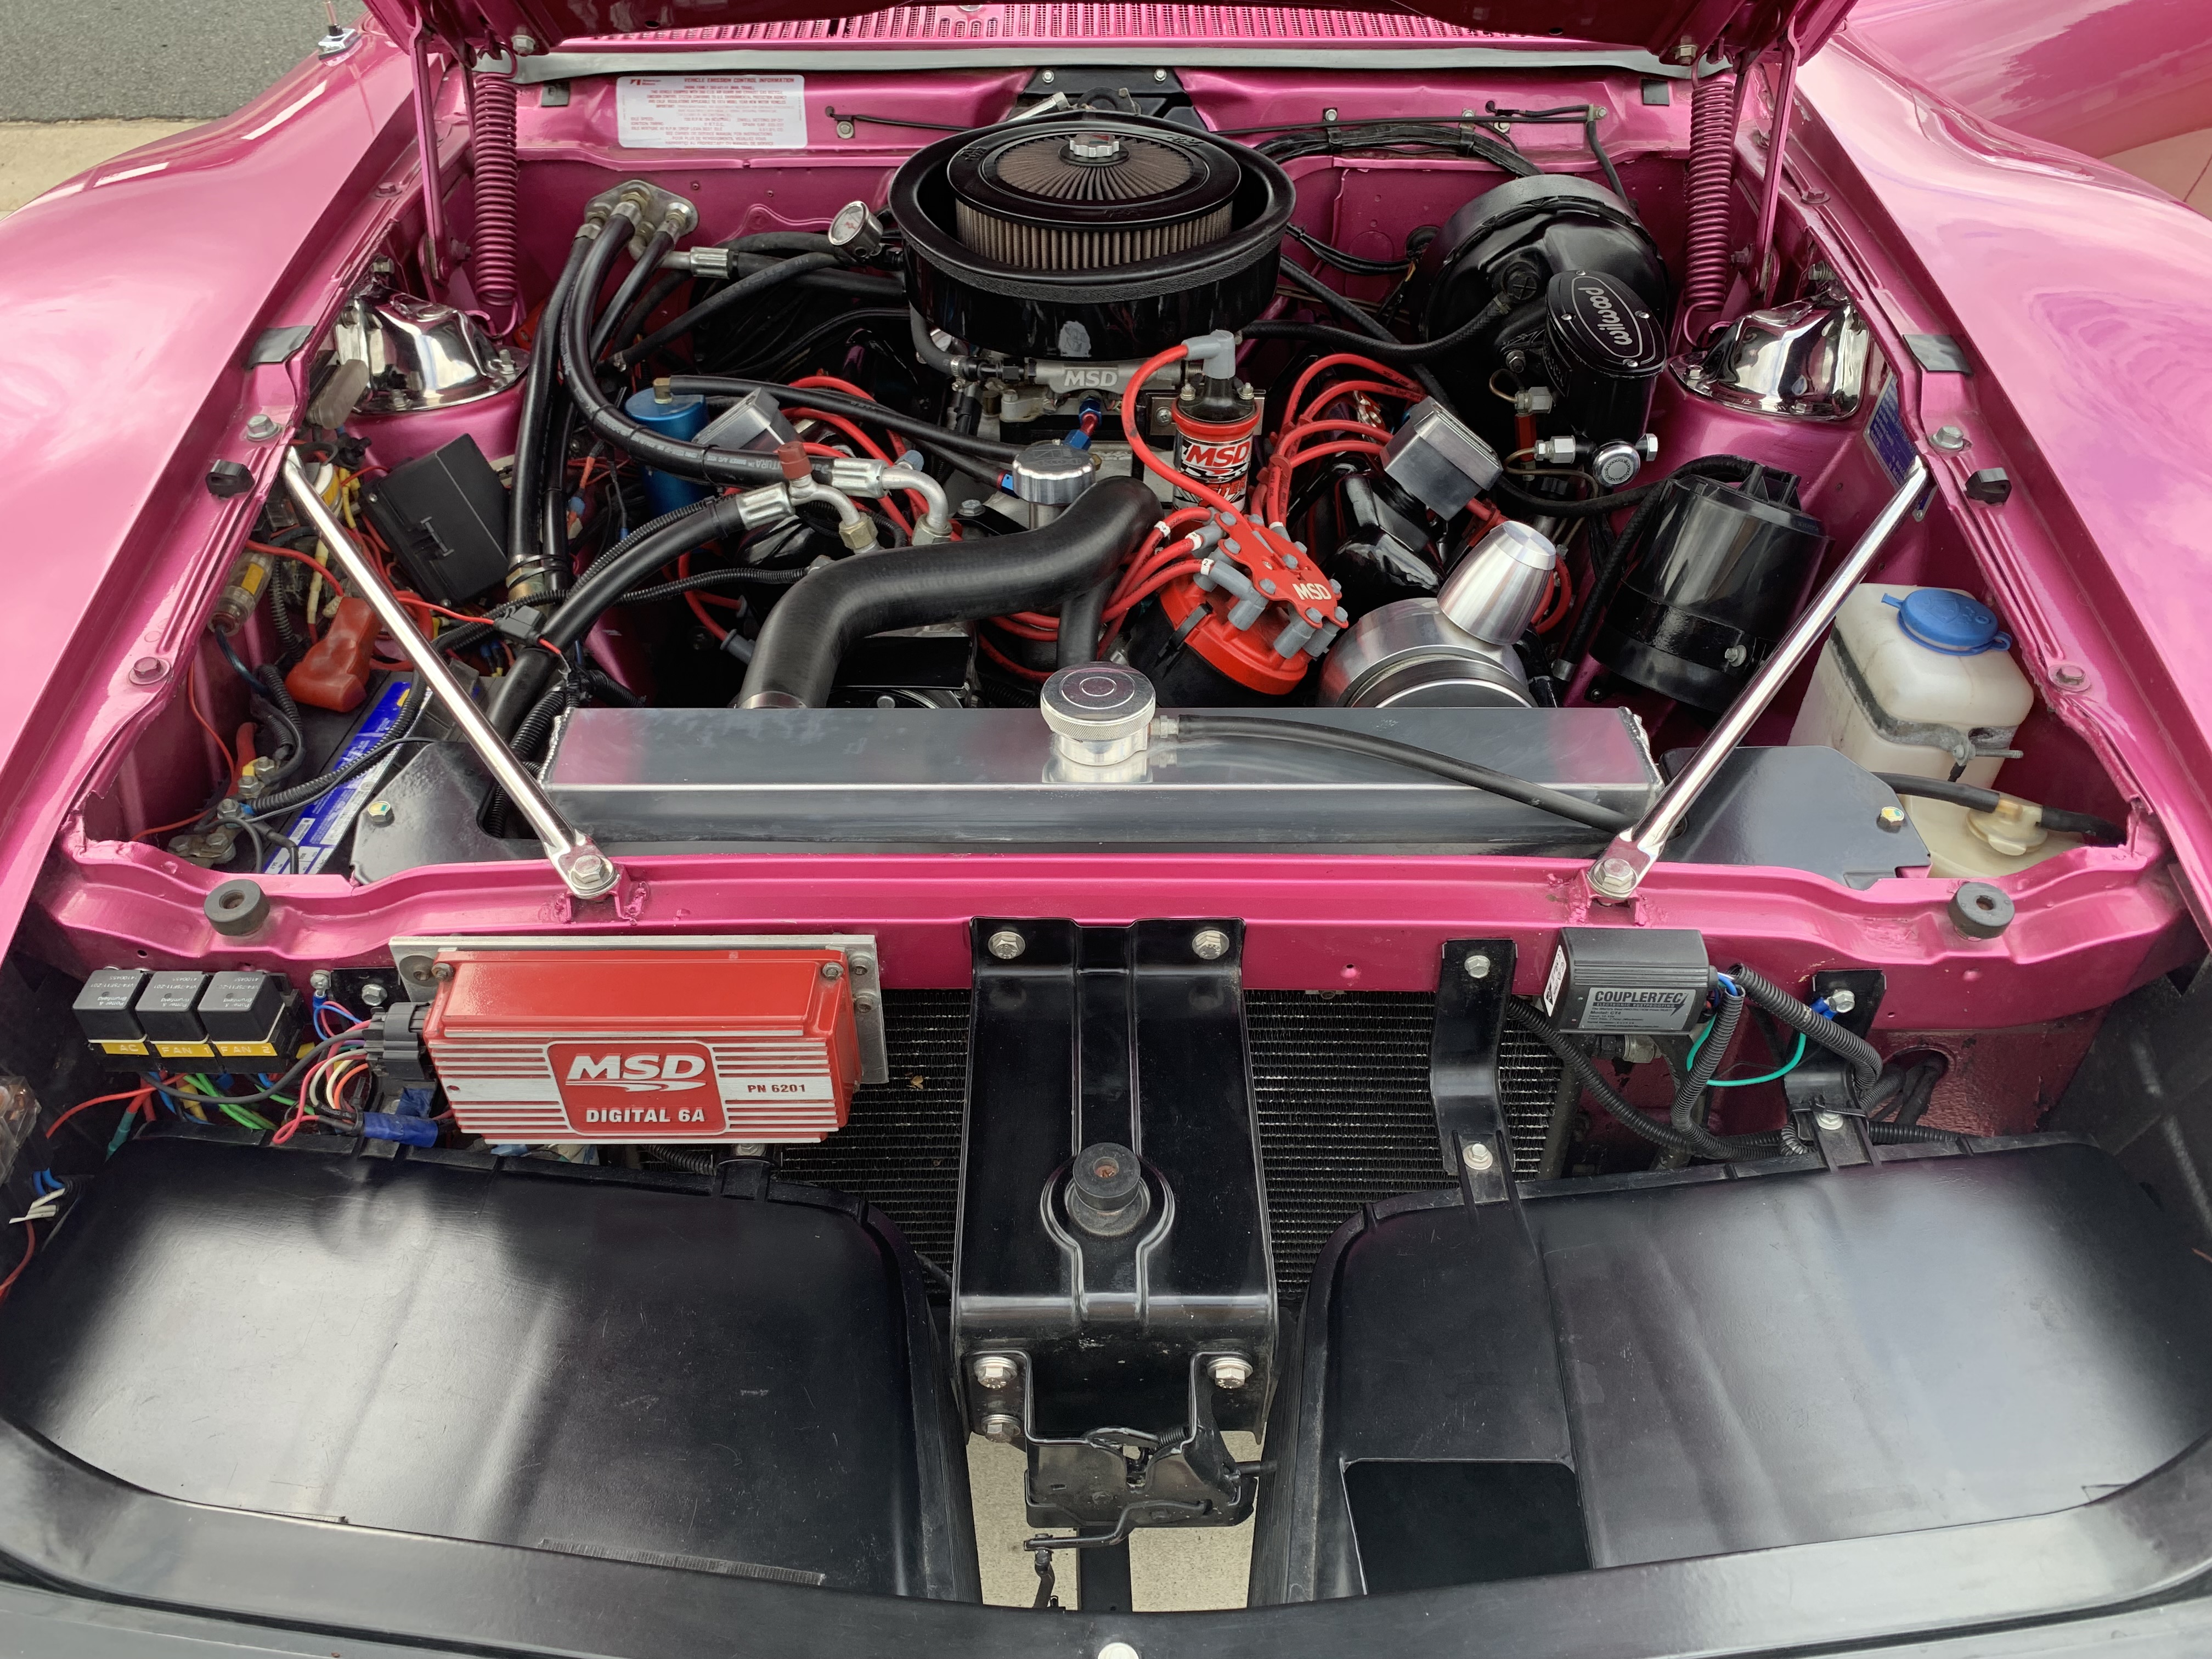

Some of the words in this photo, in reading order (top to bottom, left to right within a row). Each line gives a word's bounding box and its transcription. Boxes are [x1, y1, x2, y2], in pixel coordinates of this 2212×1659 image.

[1578, 286, 1633, 346] wilwood
[1064, 370, 1118, 387] MSD
[1186, 441, 1250, 467] MSD
[1291, 583, 1332, 601] MSD
[1595, 991, 1683, 1003] COUPLERTEC
[220, 1046, 251, 1054] FAN
[566, 1054, 707, 1080] MSD
[747, 1084, 768, 1093] PN
[771, 1084, 806, 1093] 6201
[586, 1107, 672, 1124] DIGITAL
[678, 1107, 706, 1124] 6A
